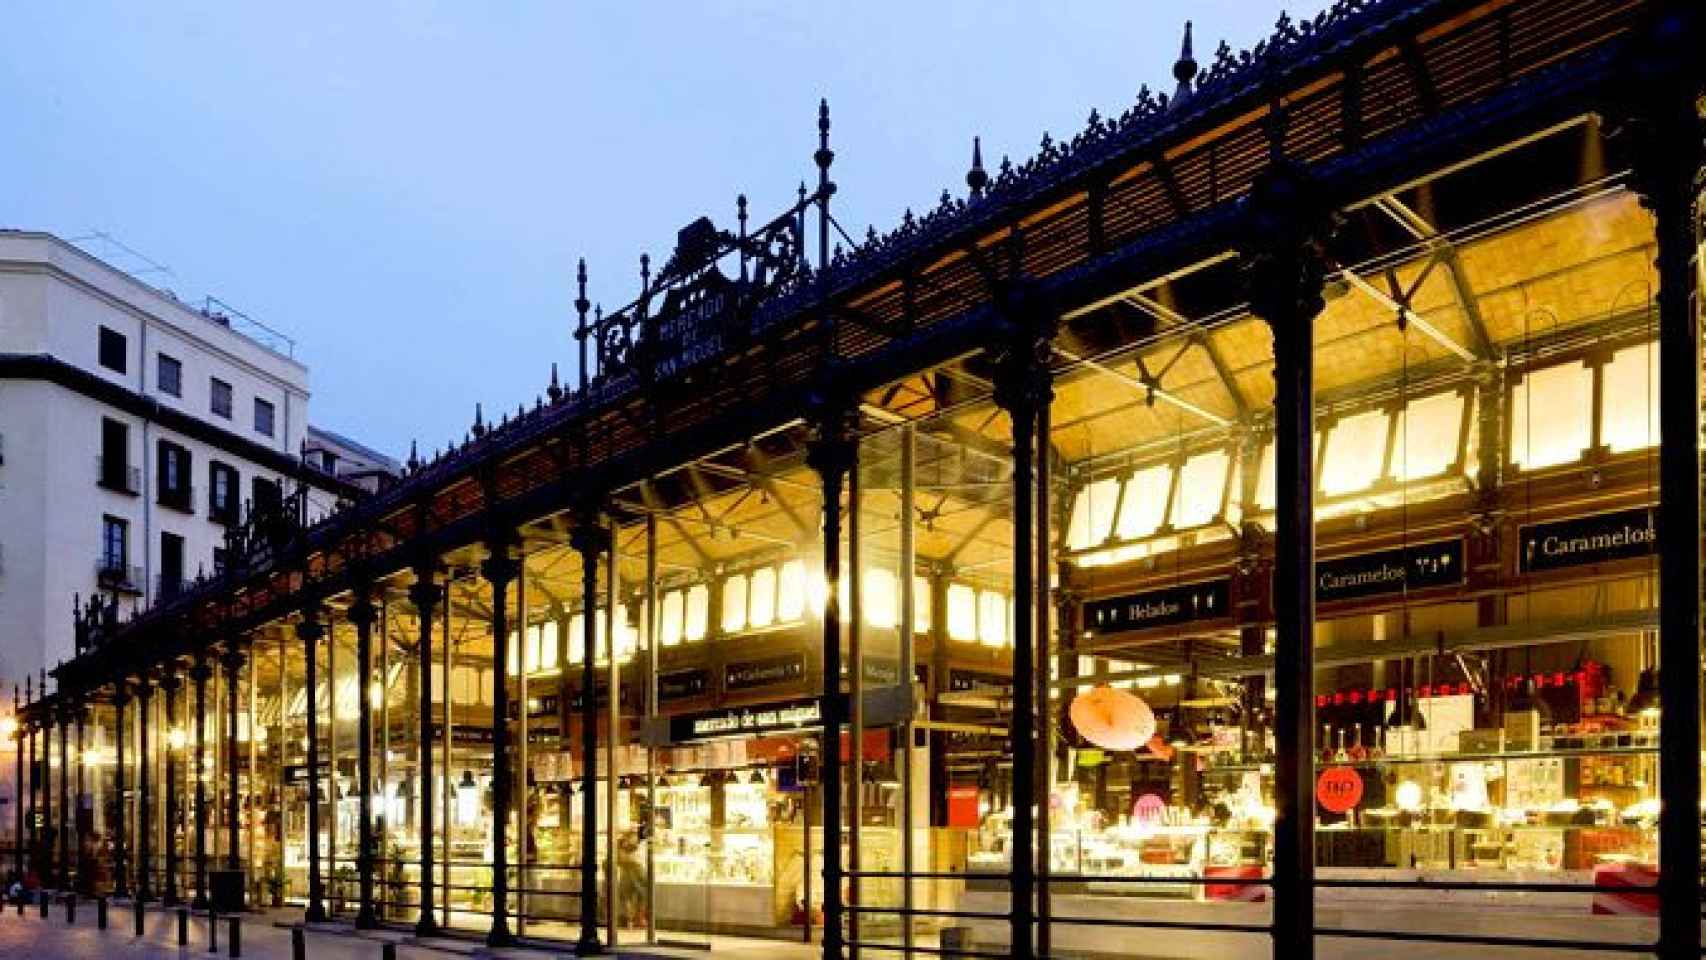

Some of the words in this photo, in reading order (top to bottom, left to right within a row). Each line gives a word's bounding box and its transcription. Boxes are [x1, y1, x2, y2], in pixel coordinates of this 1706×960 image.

[1543, 525, 1657, 556] Caramelos
[1318, 563, 1407, 590] Caramelos
[1129, 600, 1179, 620] Helados
